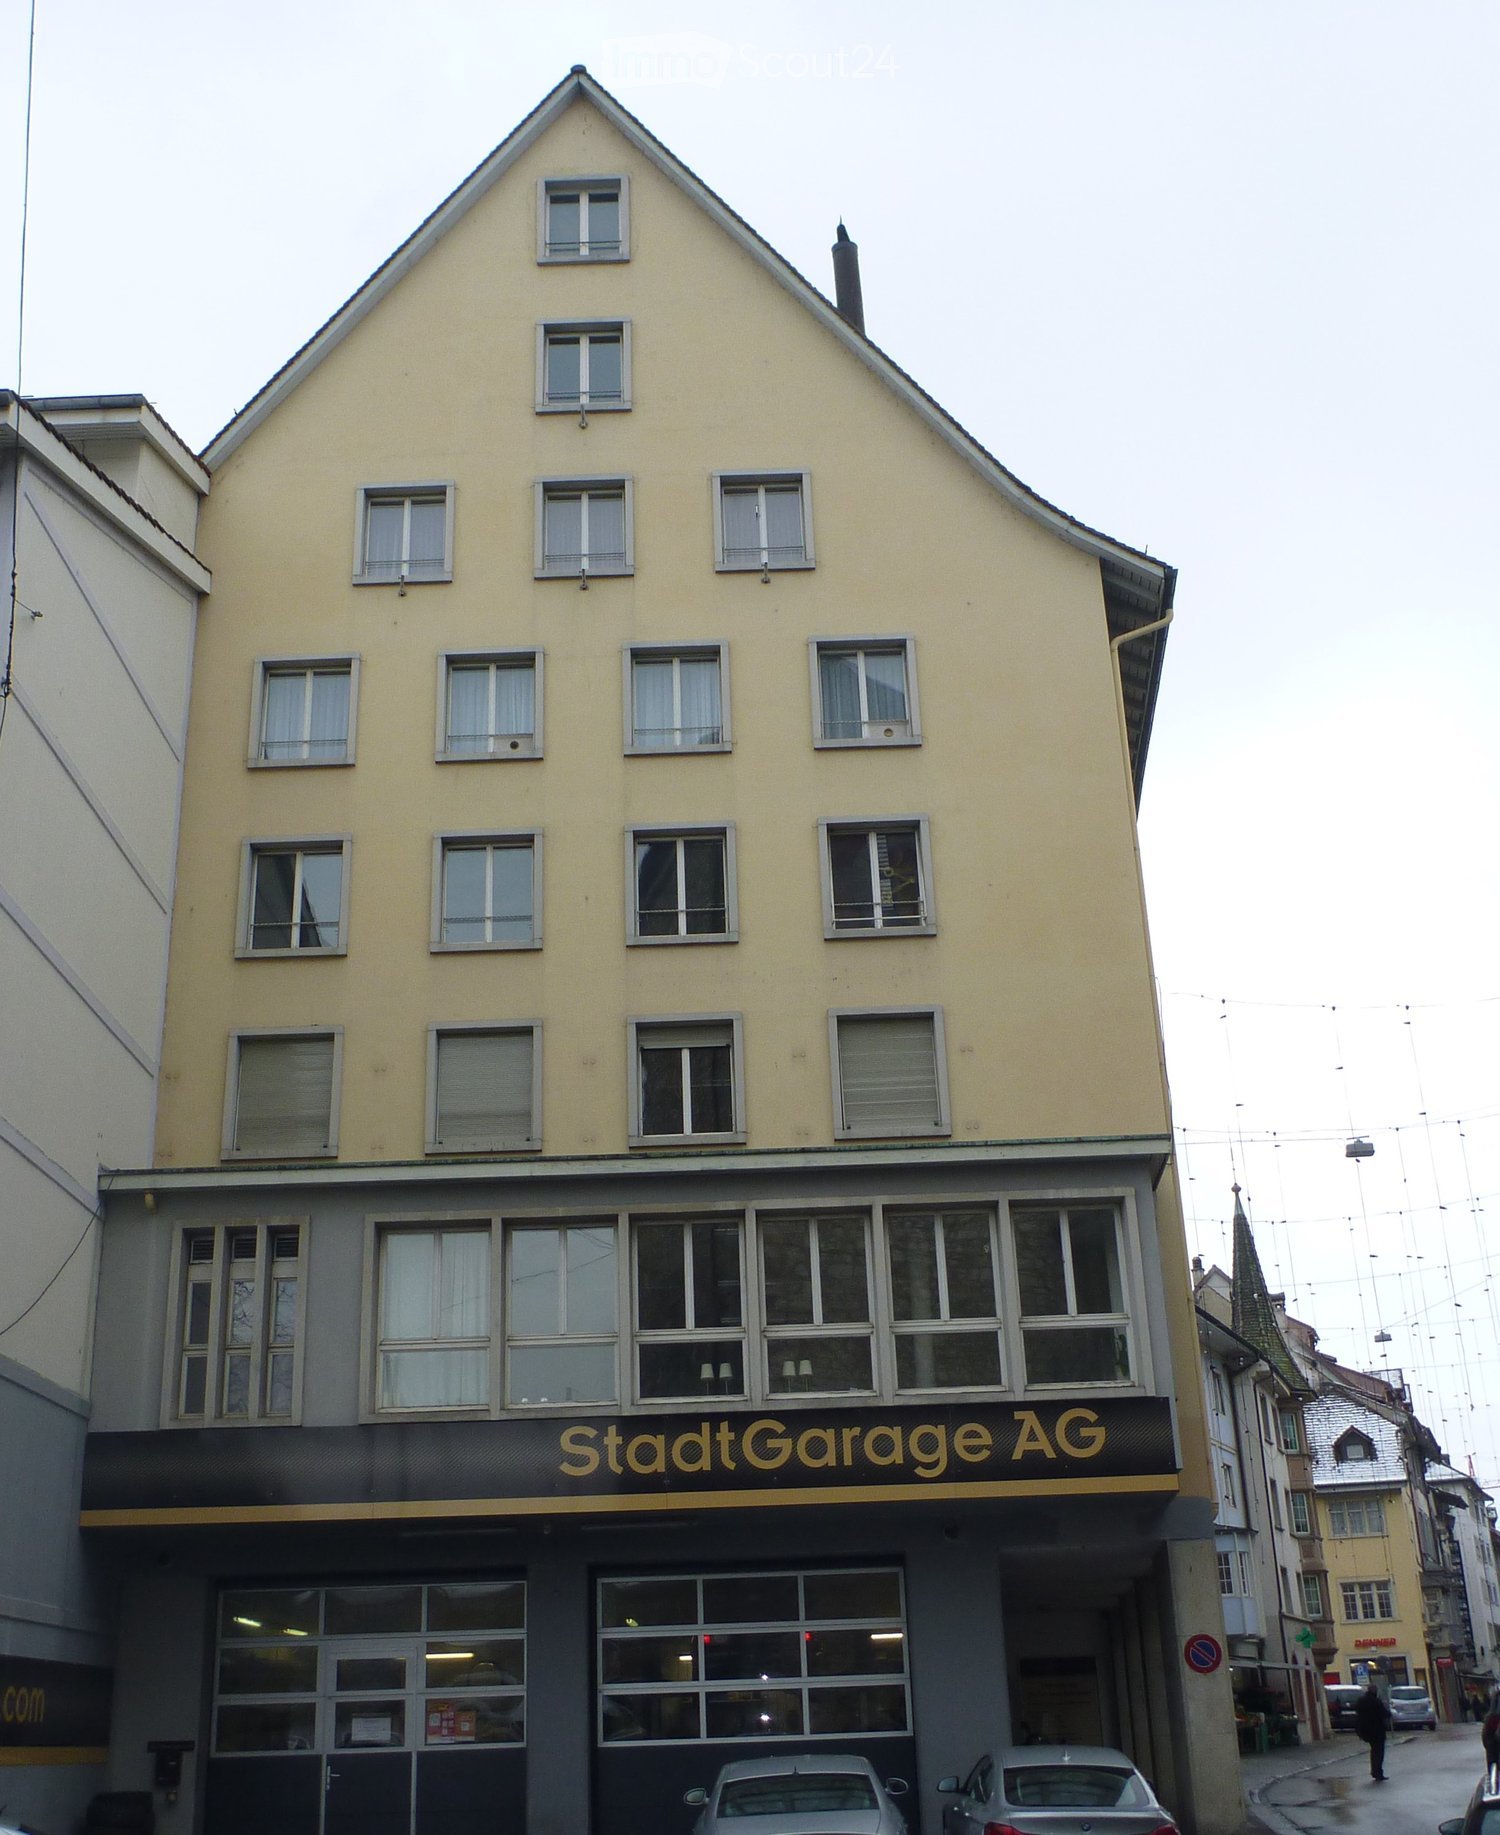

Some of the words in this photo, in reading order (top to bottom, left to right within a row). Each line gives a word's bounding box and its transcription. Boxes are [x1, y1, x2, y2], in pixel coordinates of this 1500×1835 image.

[559, 1418, 992, 1478] StadtGarage
[1012, 1408, 1107, 1460] AG
[1355, 1638, 1396, 1648] DENNER
